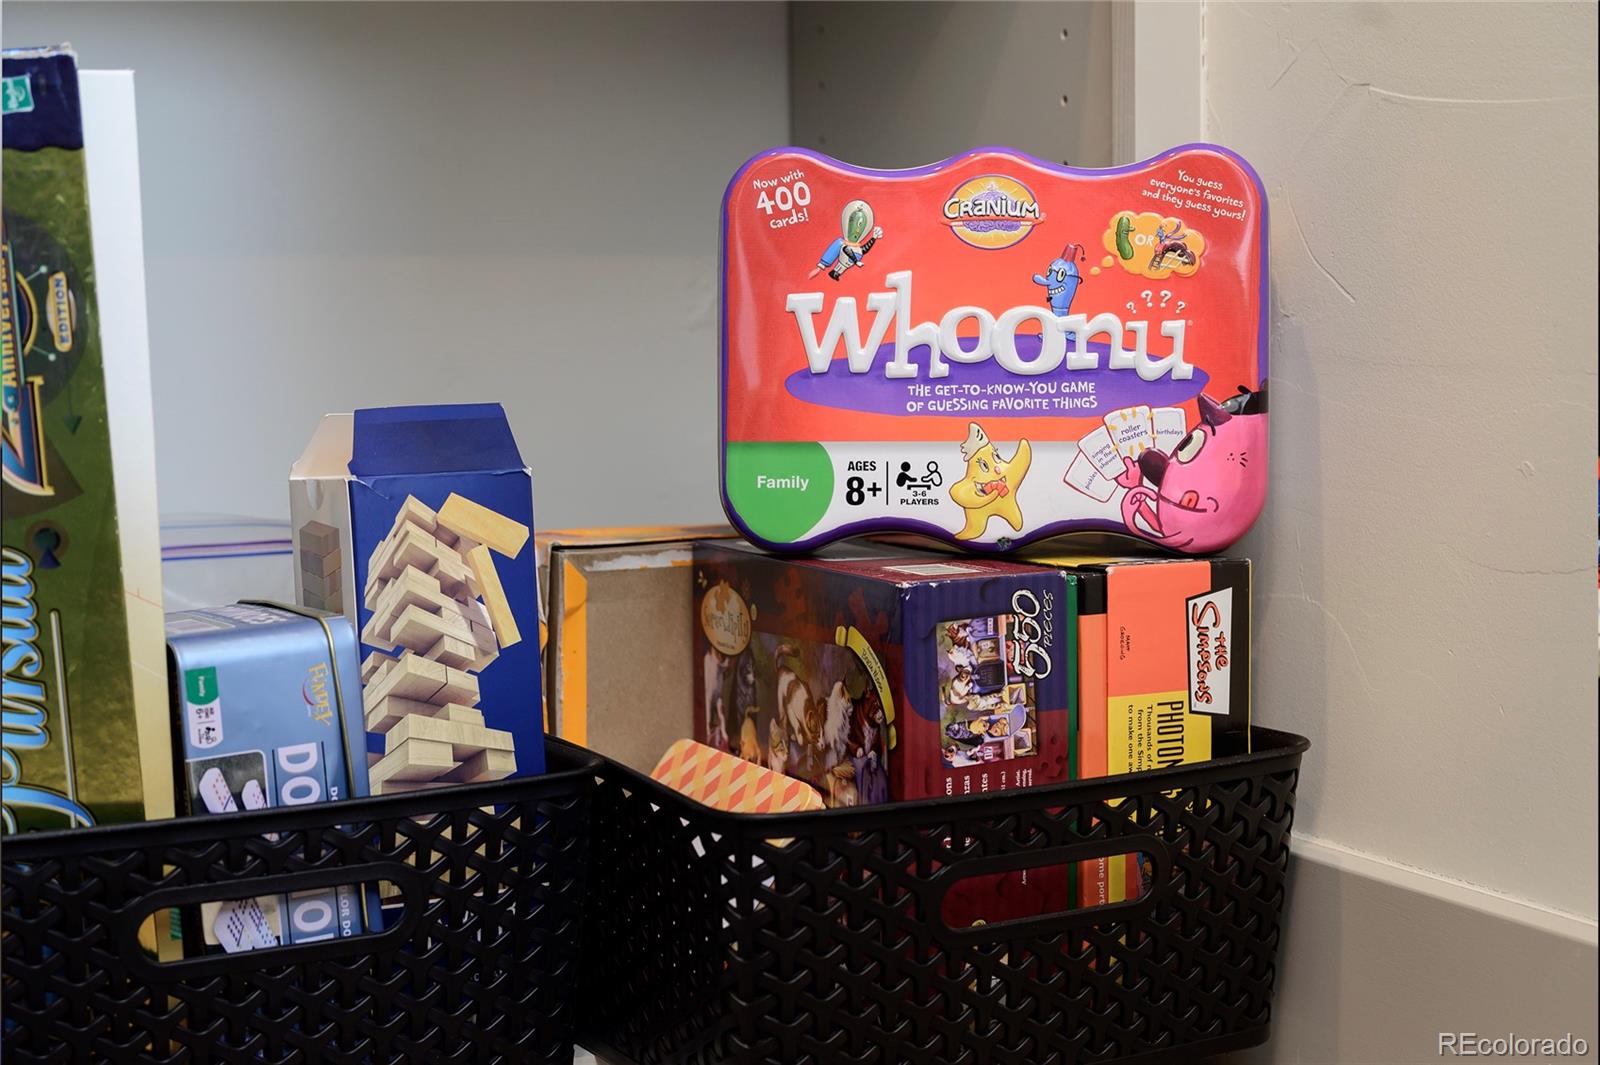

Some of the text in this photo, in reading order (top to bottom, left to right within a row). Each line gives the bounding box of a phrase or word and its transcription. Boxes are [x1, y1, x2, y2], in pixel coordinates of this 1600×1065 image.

[753, 169, 805, 190] Now with
[1178, 170, 1224, 191] You guess
[757, 181, 811, 216] 400
[1150, 178, 1245, 209] everyone's favorites
[1142, 188, 1247, 222] and they guess yours!
[770, 208, 809, 230] cards!
[1134, 233, 1155, 247] OR
[54, 278, 69, 344] EDITION
[907, 380, 1096, 397] THE GET-TO-KNOW-YOU GAME
[906, 395, 1098, 413] OF GUESSING FAVORITE THINGS
[1119, 430, 1149, 444] coasters
[1121, 424, 1142, 435] roller
[847, 460, 877, 472] AGES
[756, 475, 810, 492] Family
[845, 476, 883, 506] 8+
[900, 498, 940, 506] PLAYERS
[1012, 589, 1052, 680] 550
[1128, 704, 1133, 714] to
[1146, 753, 1153, 763] of
